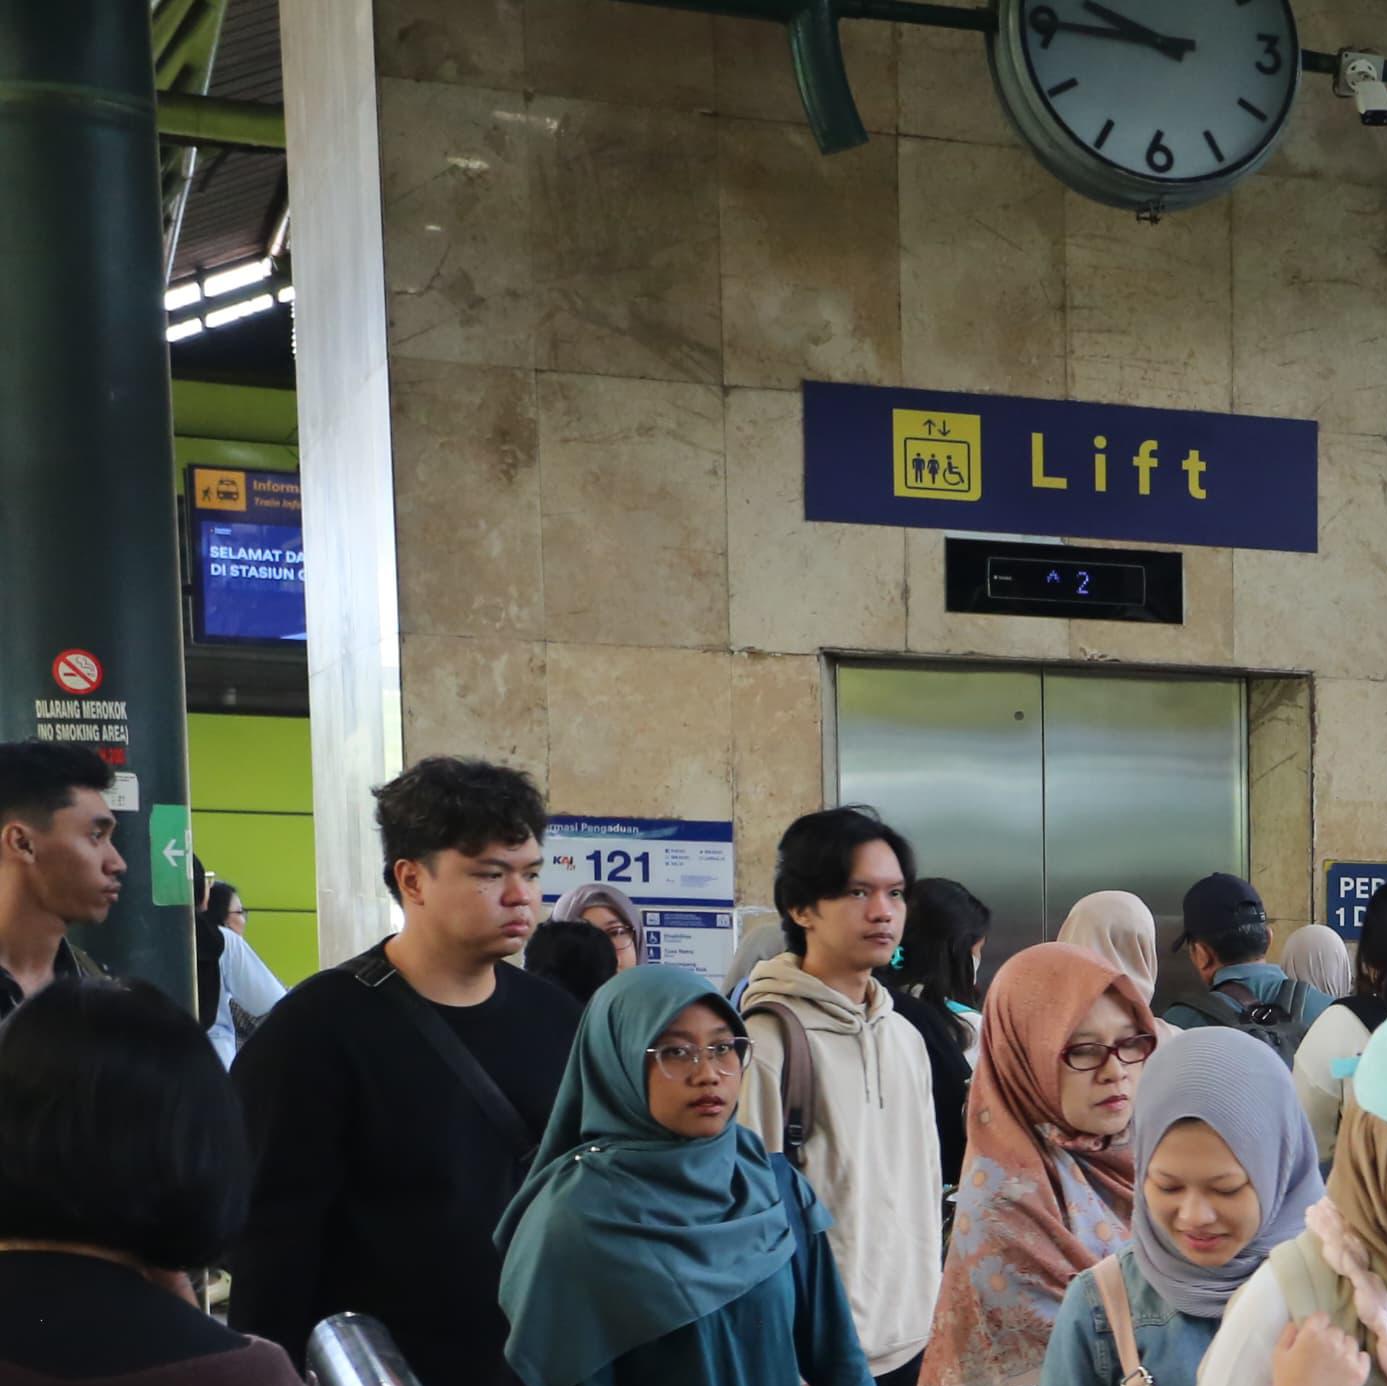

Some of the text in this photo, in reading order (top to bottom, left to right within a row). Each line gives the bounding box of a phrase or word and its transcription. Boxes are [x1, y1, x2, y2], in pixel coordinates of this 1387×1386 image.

[1255, 33, 1282, 75] 3
[1145, 129, 1174, 173] 6
[1031, 431, 1207, 500] Lift
[253, 480, 302, 493] Inform
[210, 545, 282, 562] SELAMAT
[210, 563, 226, 576] DI
[229, 564, 295, 580] STASIUN
[1076, 571, 1089, 595] 2
[35, 700, 128, 720] DILARANG MEROKOK
[55, 723, 100, 741] SMOKING
[546, 823, 640, 835] rmasi Pengaduan
[586, 850, 650, 883] 121
